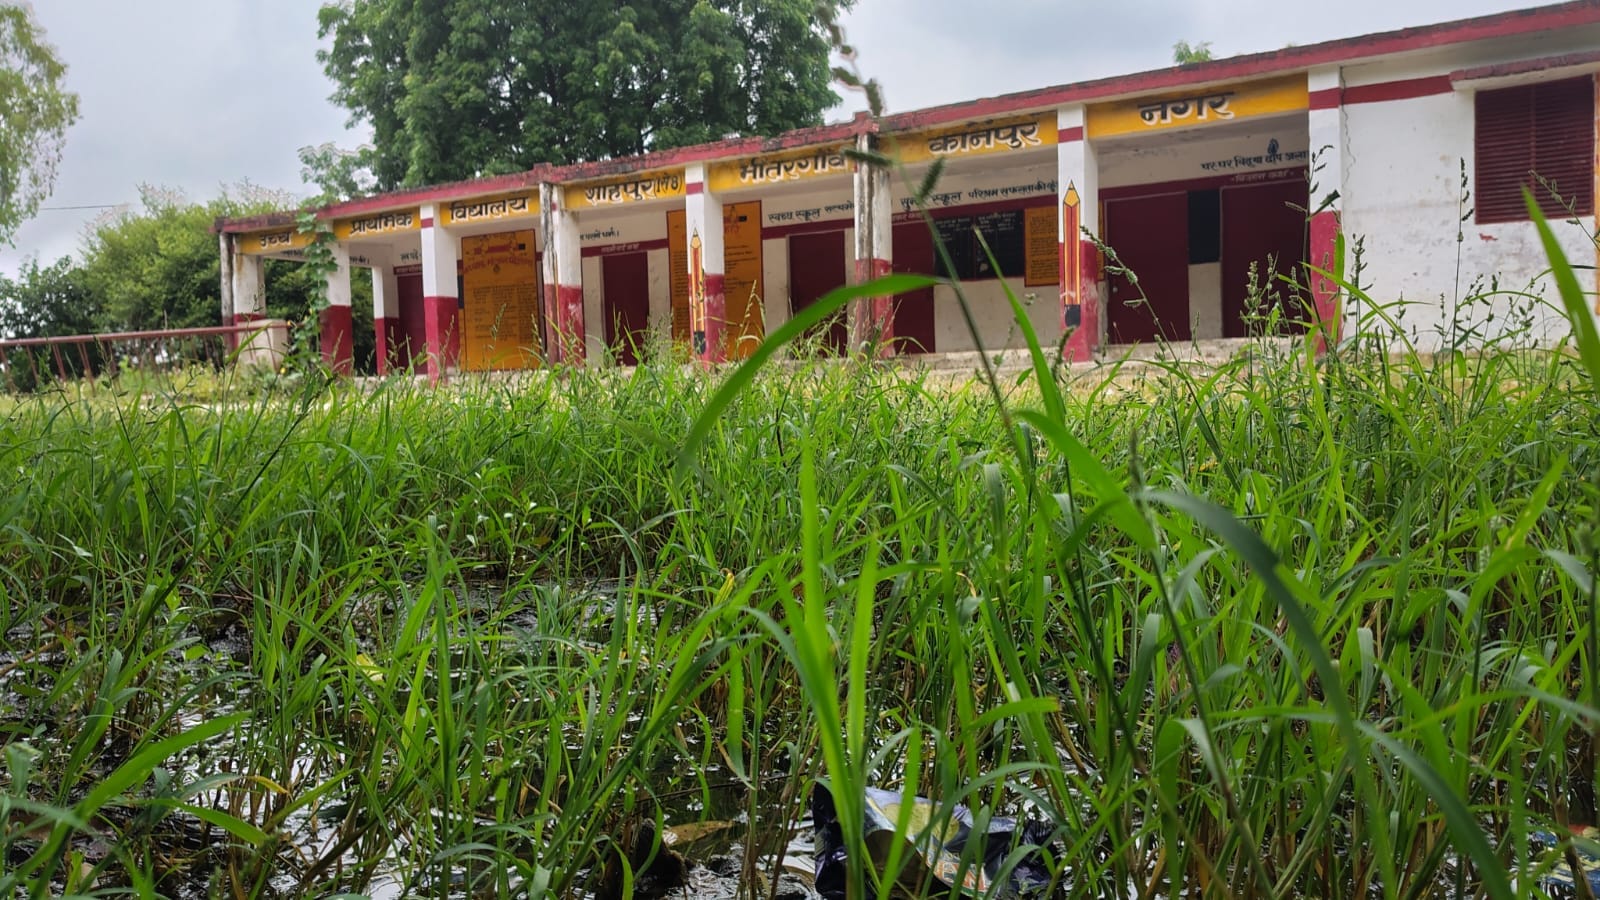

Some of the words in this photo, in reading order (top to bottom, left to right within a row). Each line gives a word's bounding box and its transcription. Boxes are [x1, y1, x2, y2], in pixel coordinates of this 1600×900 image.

[259, 231, 292, 248] उच्च
[350, 211, 413, 236] प्राथमिक
[448, 197, 530, 221] विद्यालय
[585, 179, 656, 205] शाहपुर
[928, 122, 1041, 154] कानपुर
[1137, 92, 1234, 125] नगर
